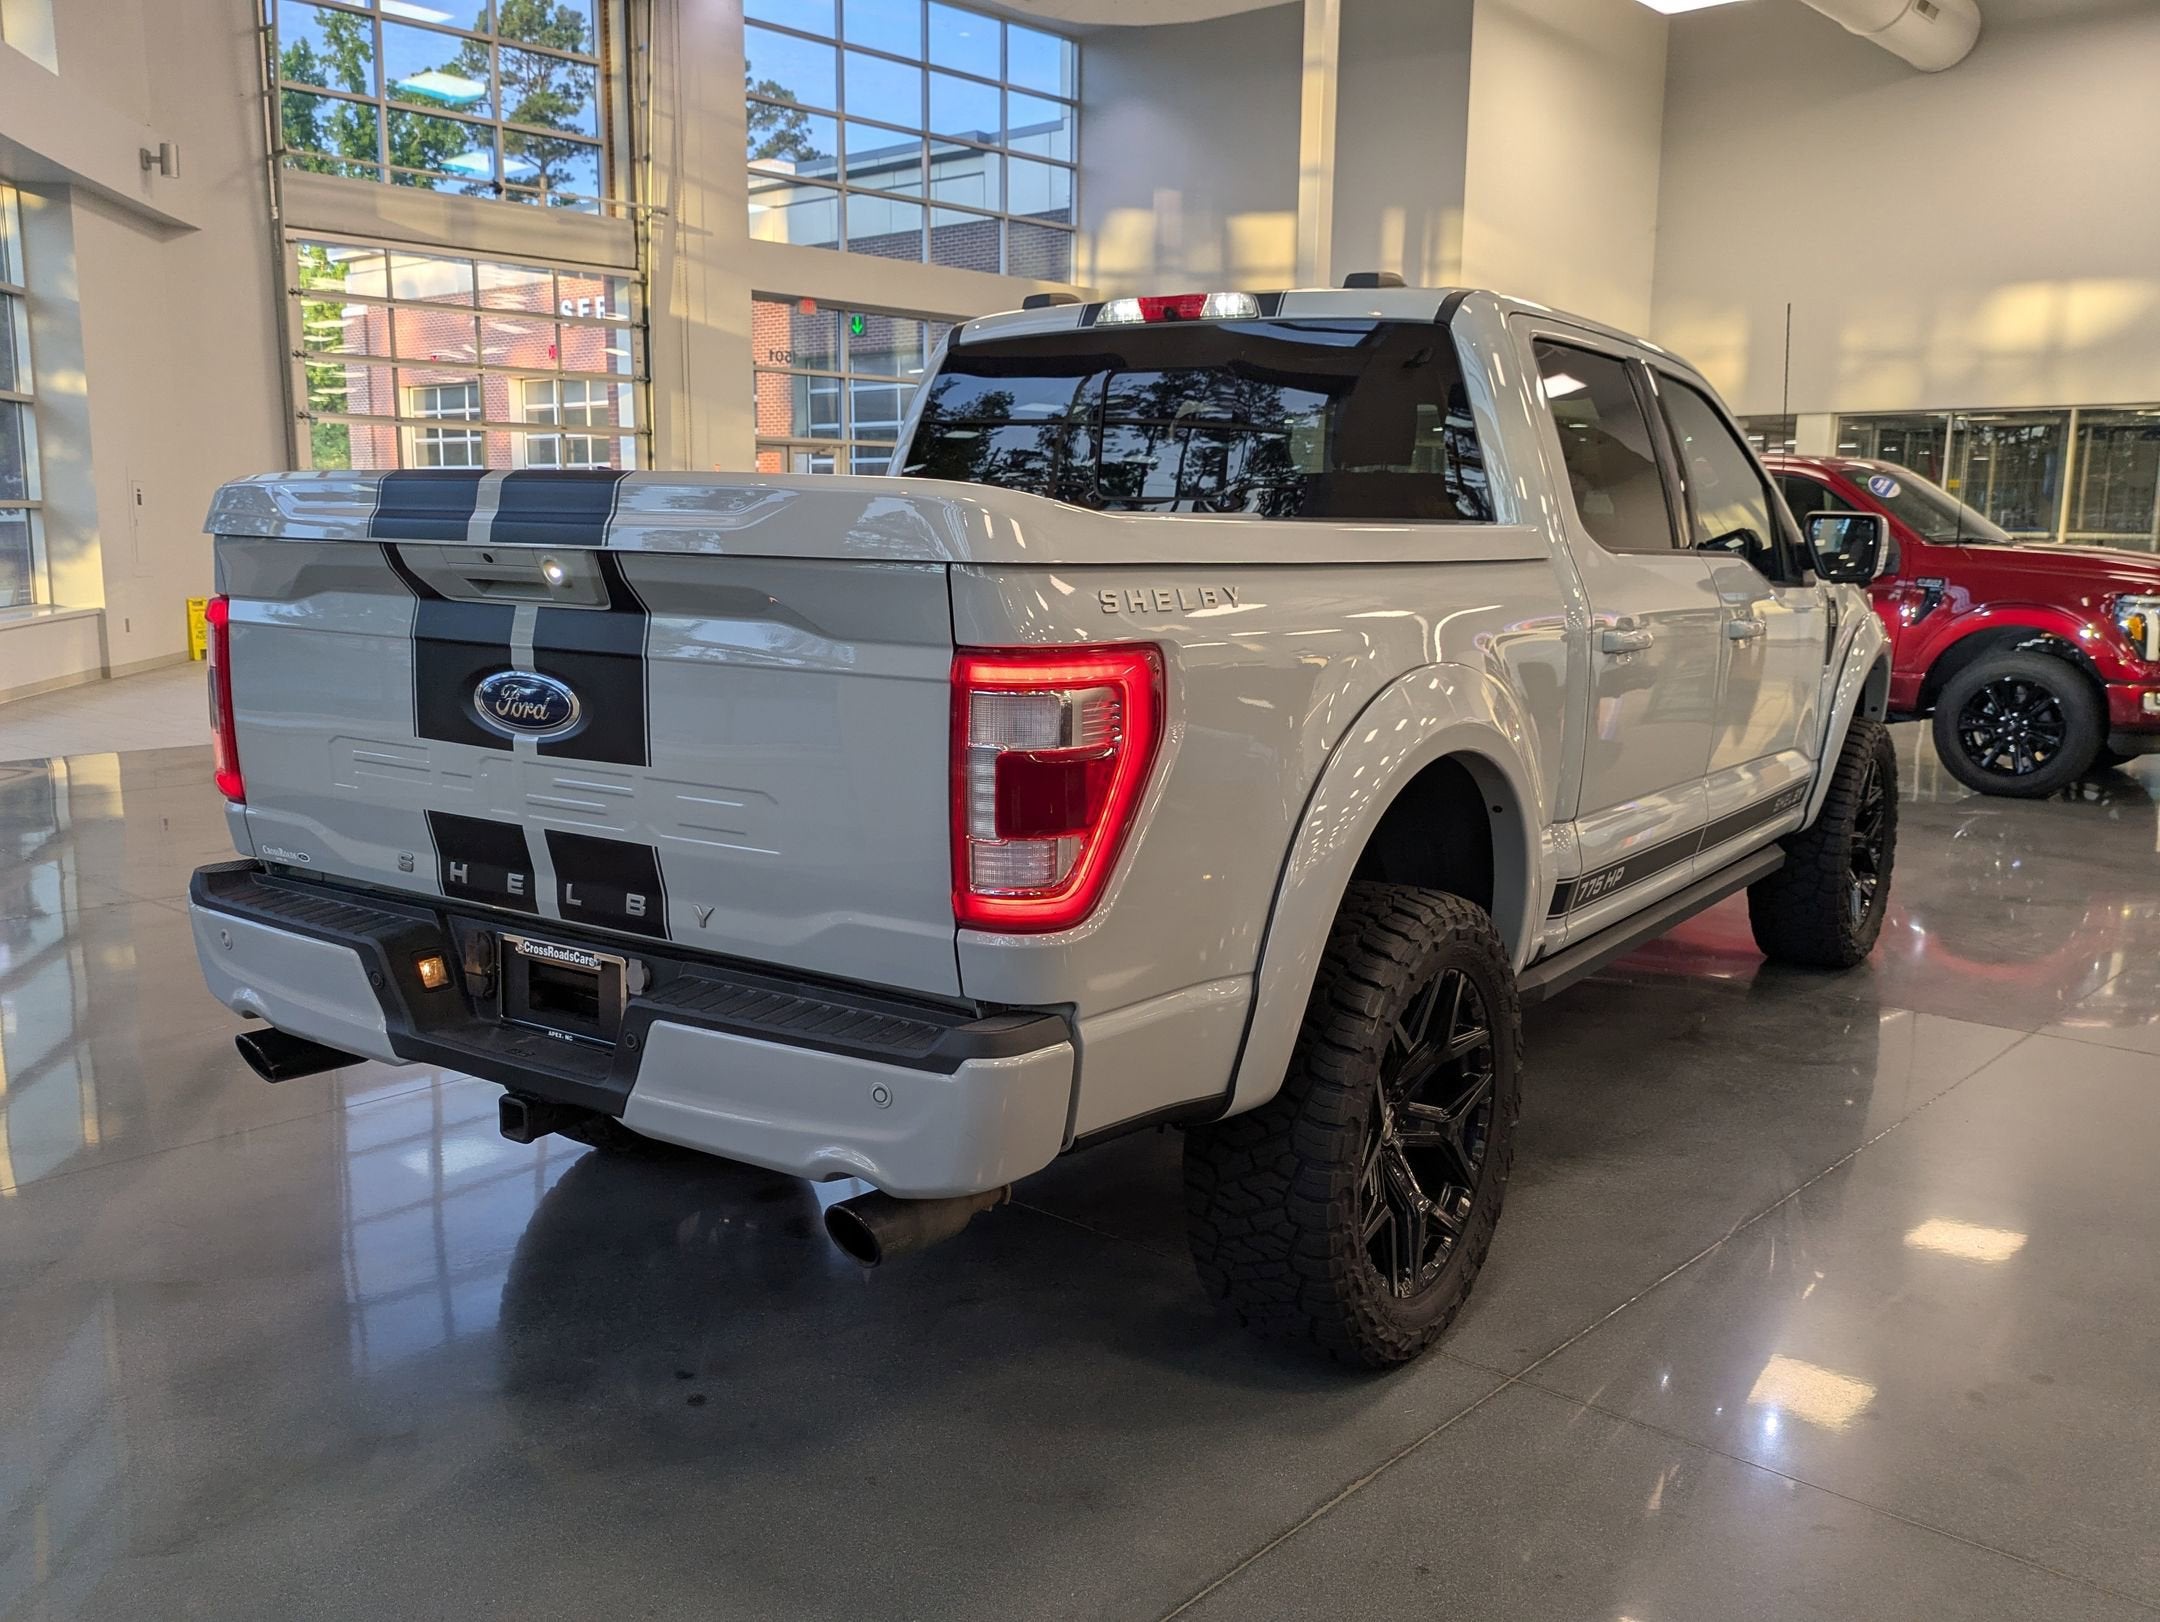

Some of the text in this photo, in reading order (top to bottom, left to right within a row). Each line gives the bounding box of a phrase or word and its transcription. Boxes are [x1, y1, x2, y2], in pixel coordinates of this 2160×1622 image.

[1098, 585, 1240, 614] SHELBY
[495, 683, 551, 721] Ford
[398, 850, 717, 930] SHELBY
[1578, 866, 1625, 903] 775 HP
